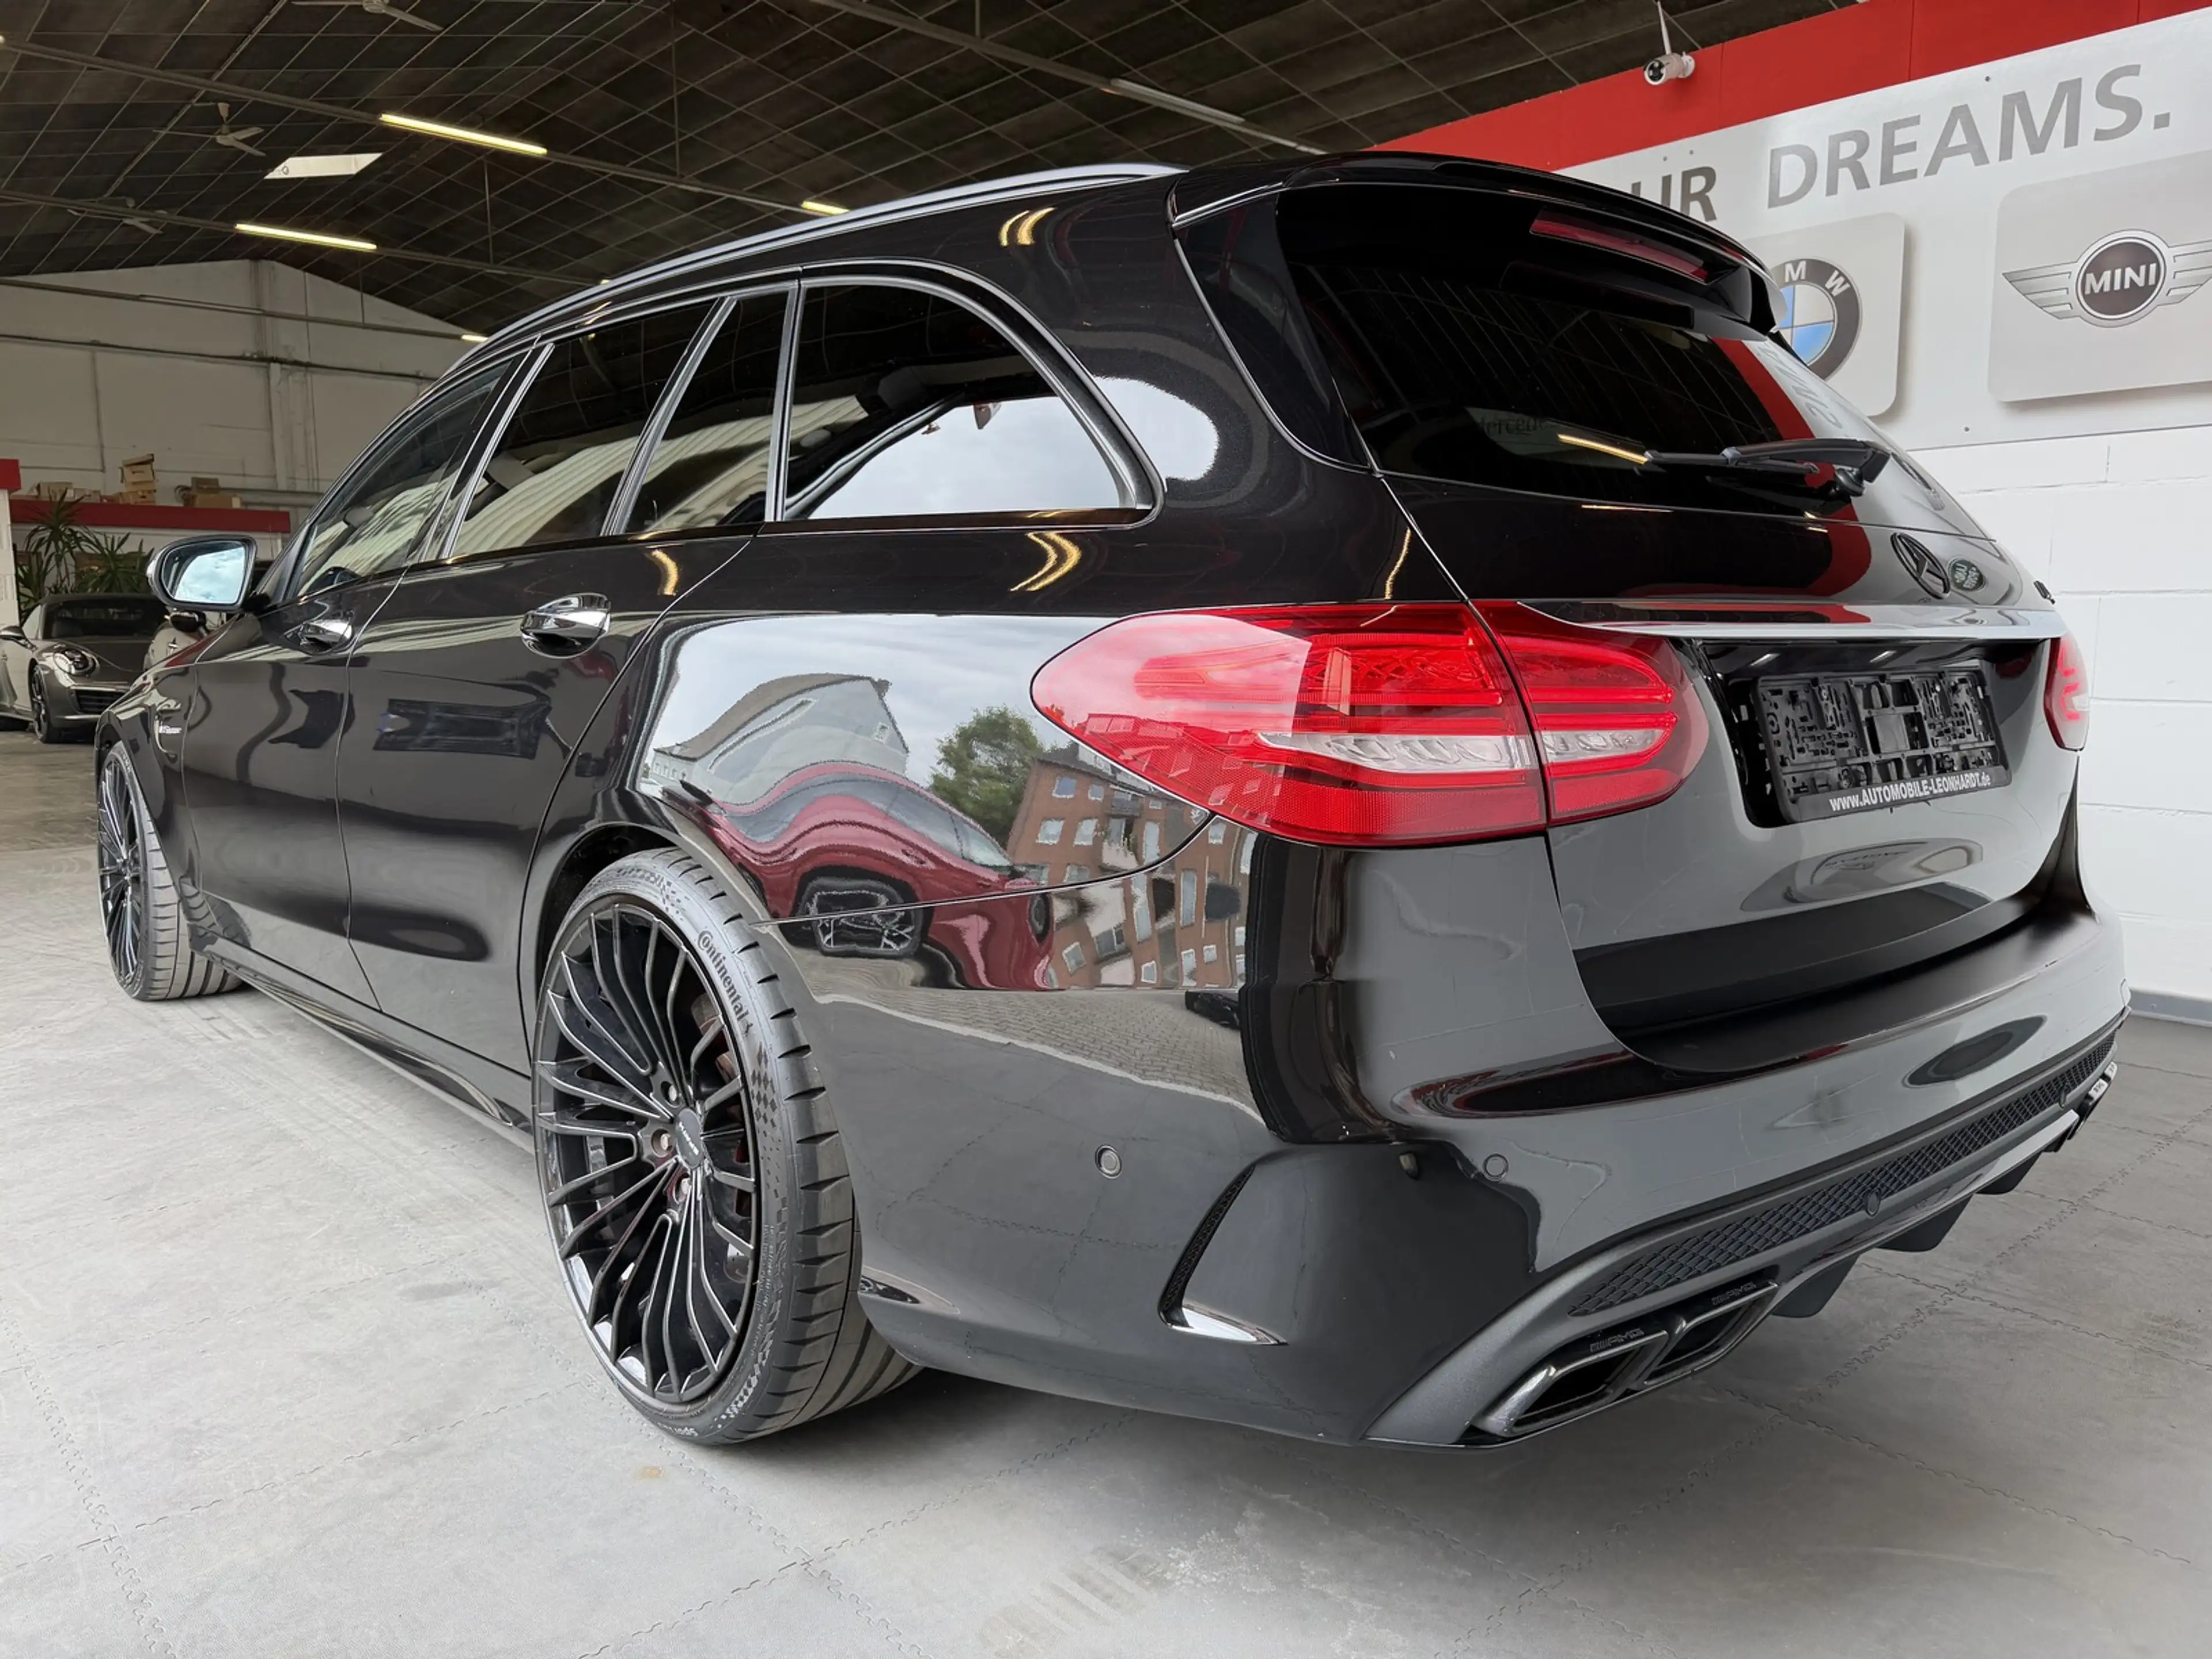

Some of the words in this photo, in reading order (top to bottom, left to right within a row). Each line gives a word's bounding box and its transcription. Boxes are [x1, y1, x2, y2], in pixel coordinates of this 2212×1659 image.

[1767, 63, 2171, 210] DREAMS.
[2084, 262, 2157, 295] MINI
[698, 930, 750, 1021] Continental
